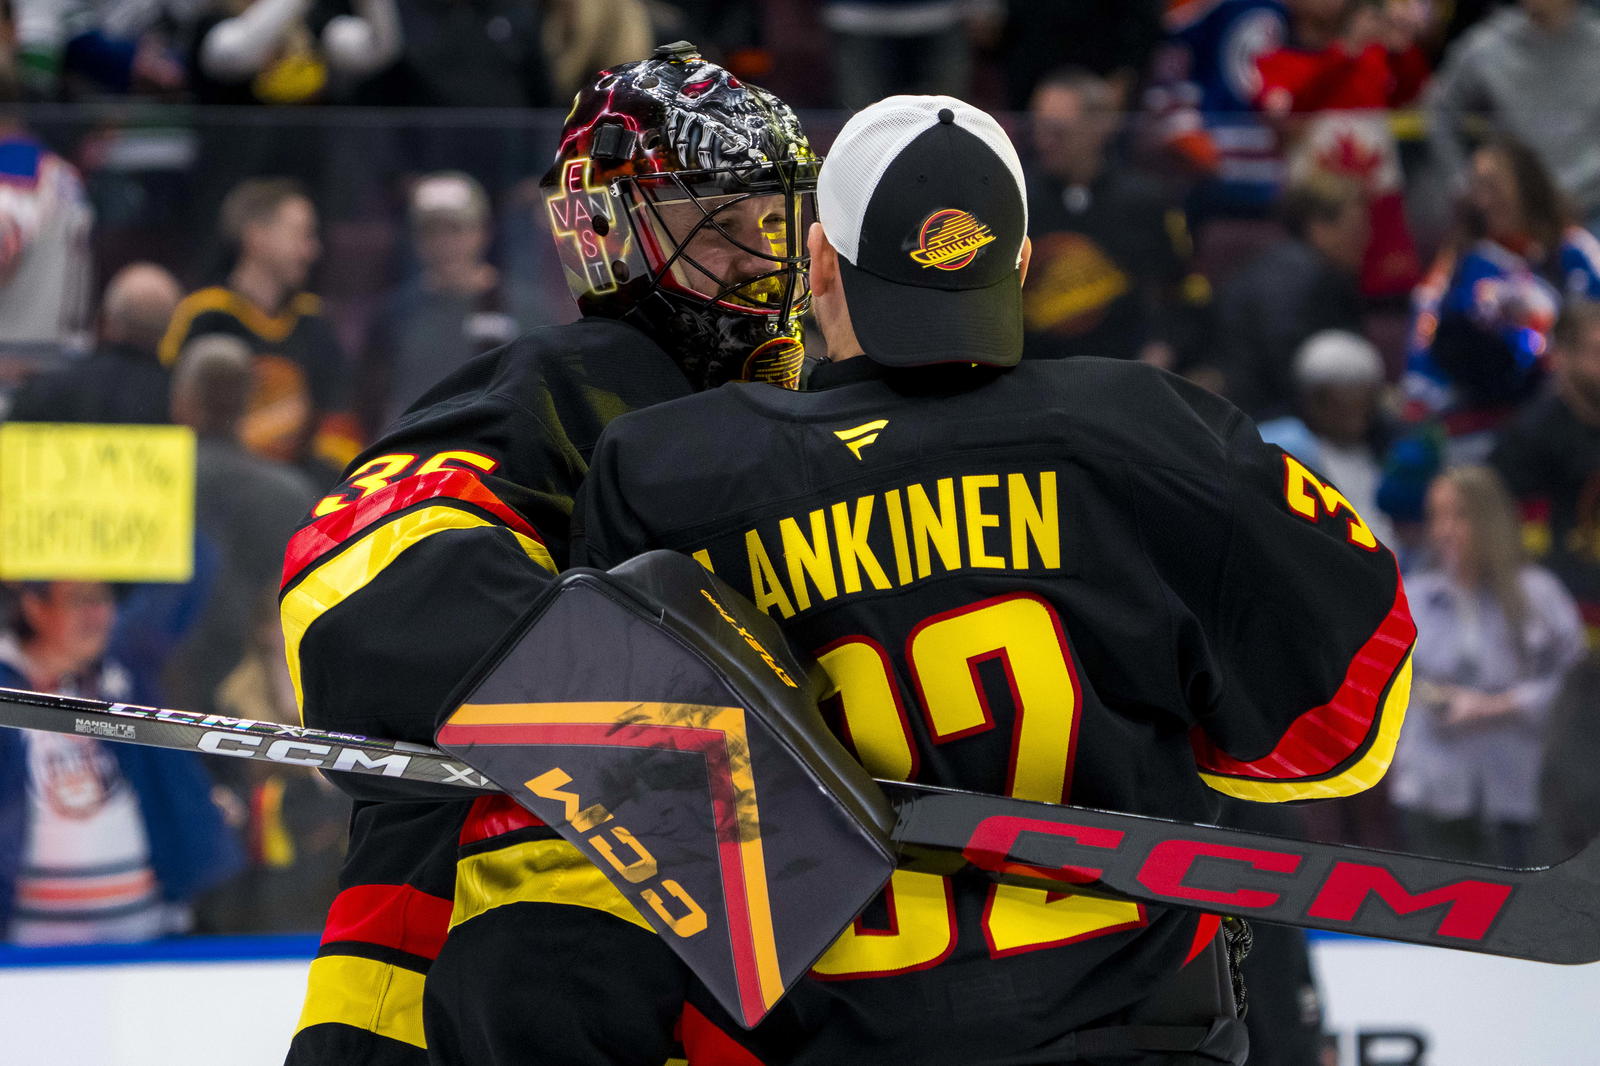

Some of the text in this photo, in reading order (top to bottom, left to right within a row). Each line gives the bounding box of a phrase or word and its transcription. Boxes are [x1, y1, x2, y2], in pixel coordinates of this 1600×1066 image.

[910, 229, 993, 265] CANUCKS
[75, 718, 136, 731] NANOLITE
[108, 702, 260, 732] CCM
[196, 730, 490, 788] CCM X
[523, 767, 708, 938] CCM
[961, 814, 1514, 943] CCM
